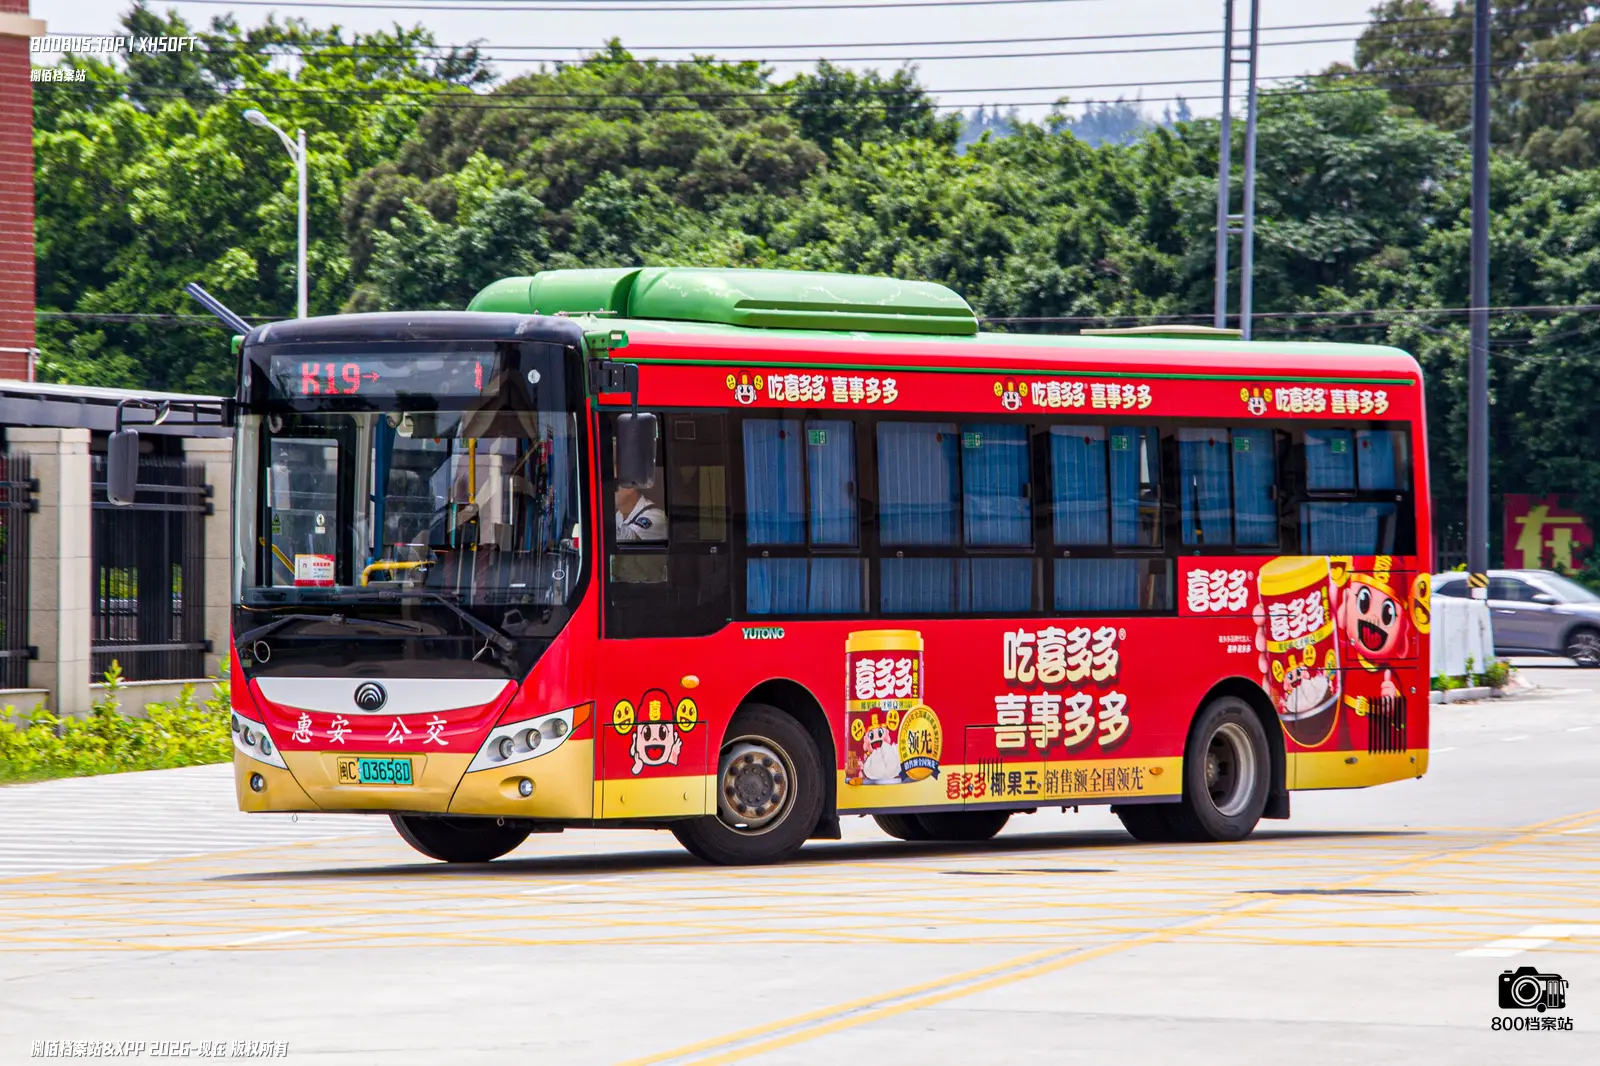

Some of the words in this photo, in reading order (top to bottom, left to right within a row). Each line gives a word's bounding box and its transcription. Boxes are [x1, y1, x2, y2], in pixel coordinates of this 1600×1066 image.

[302, 363, 361, 395] K19
[1186, 568, 1249, 613] 喜多多
[741, 627, 785, 640] YUTONG
[1003, 626, 1120, 684] 吃喜多多
[855, 657, 913, 700] 喜多多
[292, 712, 352, 745] 惠安
[384, 714, 449, 746] 公交
[993, 690, 1130, 749] 喜事多多
[907, 729, 933, 755] 领先
[1045, 766, 1145, 795] 销售额全国领先
